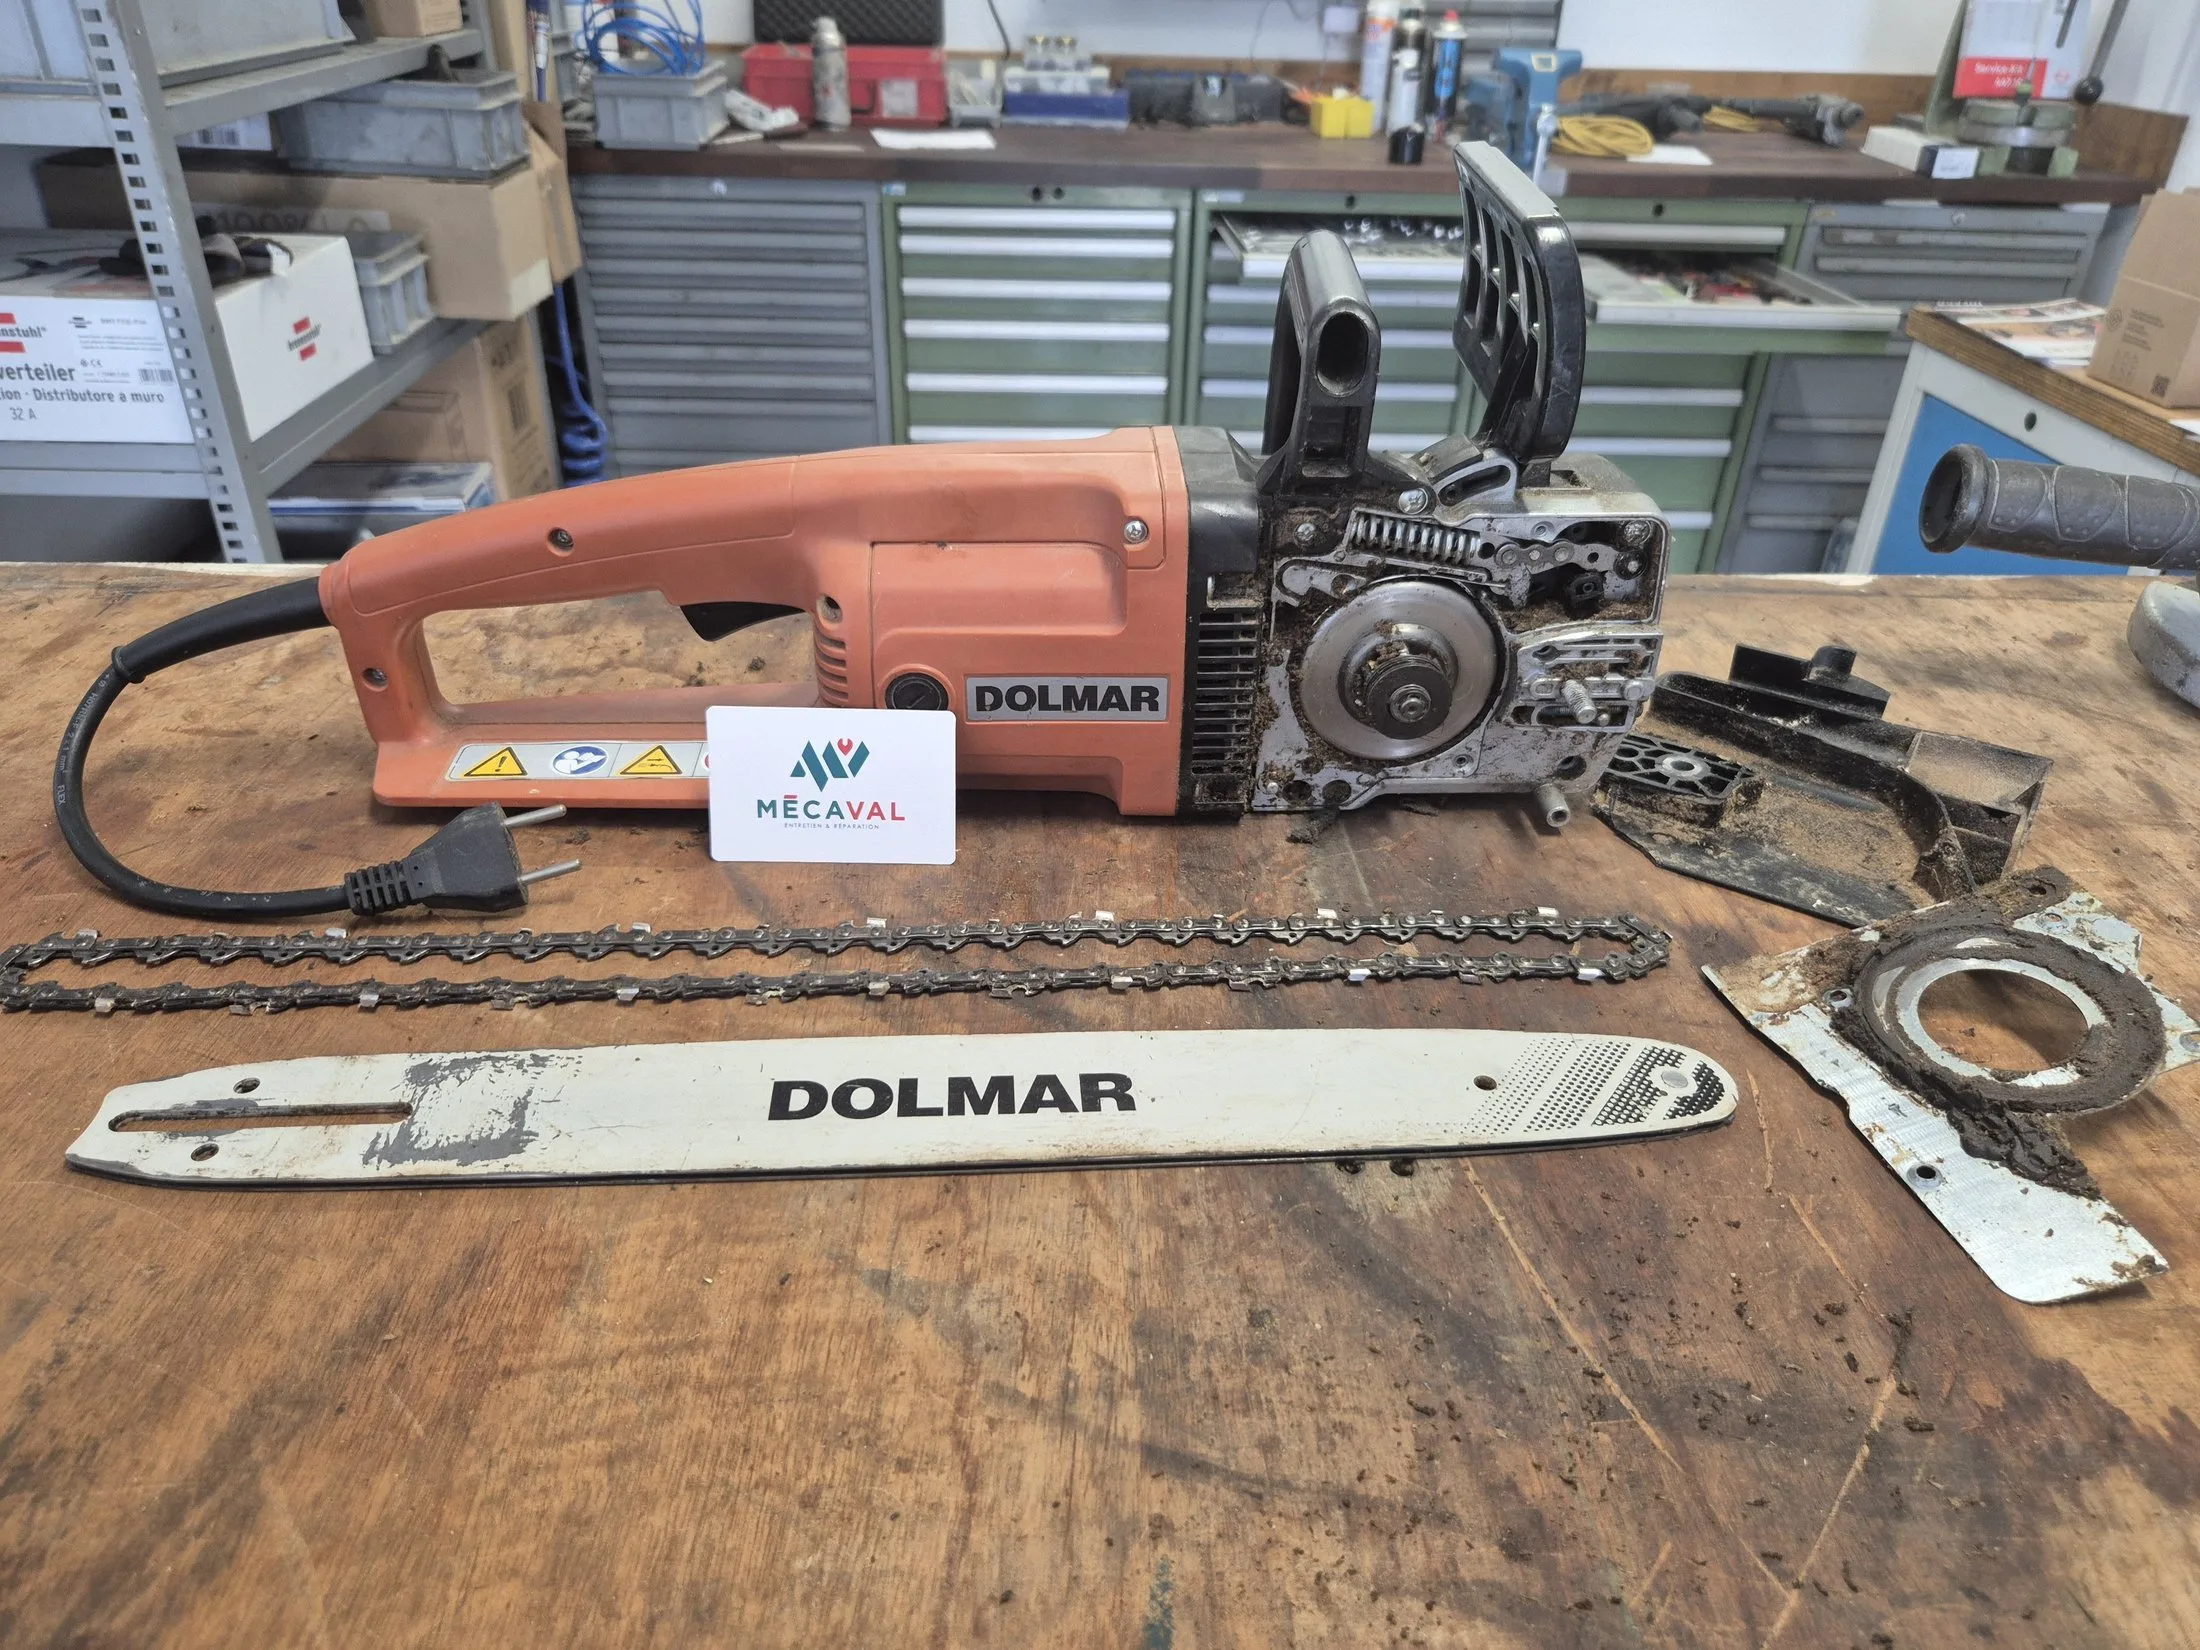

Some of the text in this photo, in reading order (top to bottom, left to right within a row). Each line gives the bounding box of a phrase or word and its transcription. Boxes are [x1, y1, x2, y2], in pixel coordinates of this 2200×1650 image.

[0, 387, 164, 404] ion Distributore a muro
[10, 407, 37, 421] 32 A
[975, 685, 1160, 712] DOLMAR
[57, 785, 66, 805] FLEX
[768, 1072, 1137, 1121] DOLMAR
